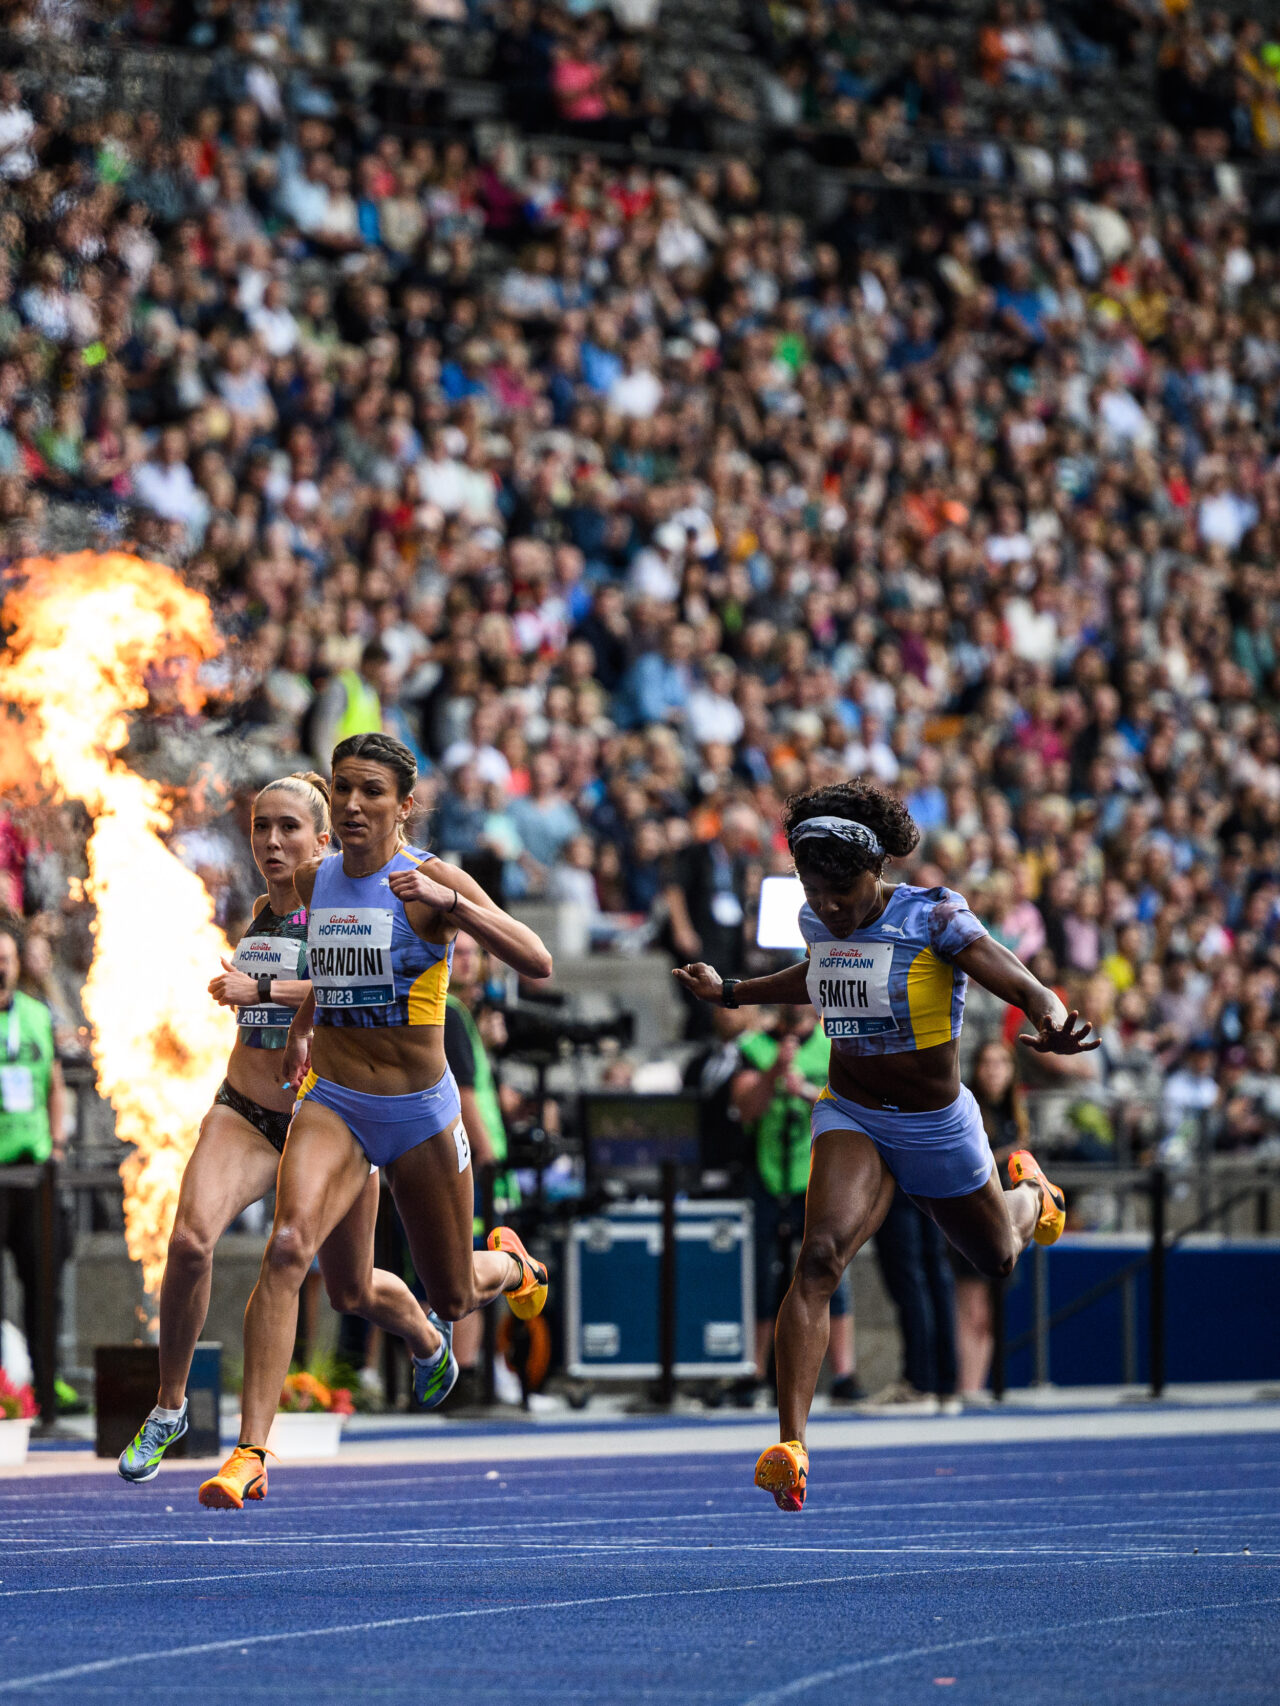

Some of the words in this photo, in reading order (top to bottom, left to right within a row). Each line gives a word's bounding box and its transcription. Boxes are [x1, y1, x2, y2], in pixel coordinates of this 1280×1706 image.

[319, 924, 372, 936] HOFFMANN
[239, 951, 281, 963] HOFFMANN
[310, 947, 383, 977] PRANDINI
[819, 957, 874, 969] HOFFMANN
[326, 990, 354, 1004] 2023
[819, 979, 869, 1009] SMITH
[241, 1010, 269, 1024] 2023
[827, 1020, 860, 1035] 2023
